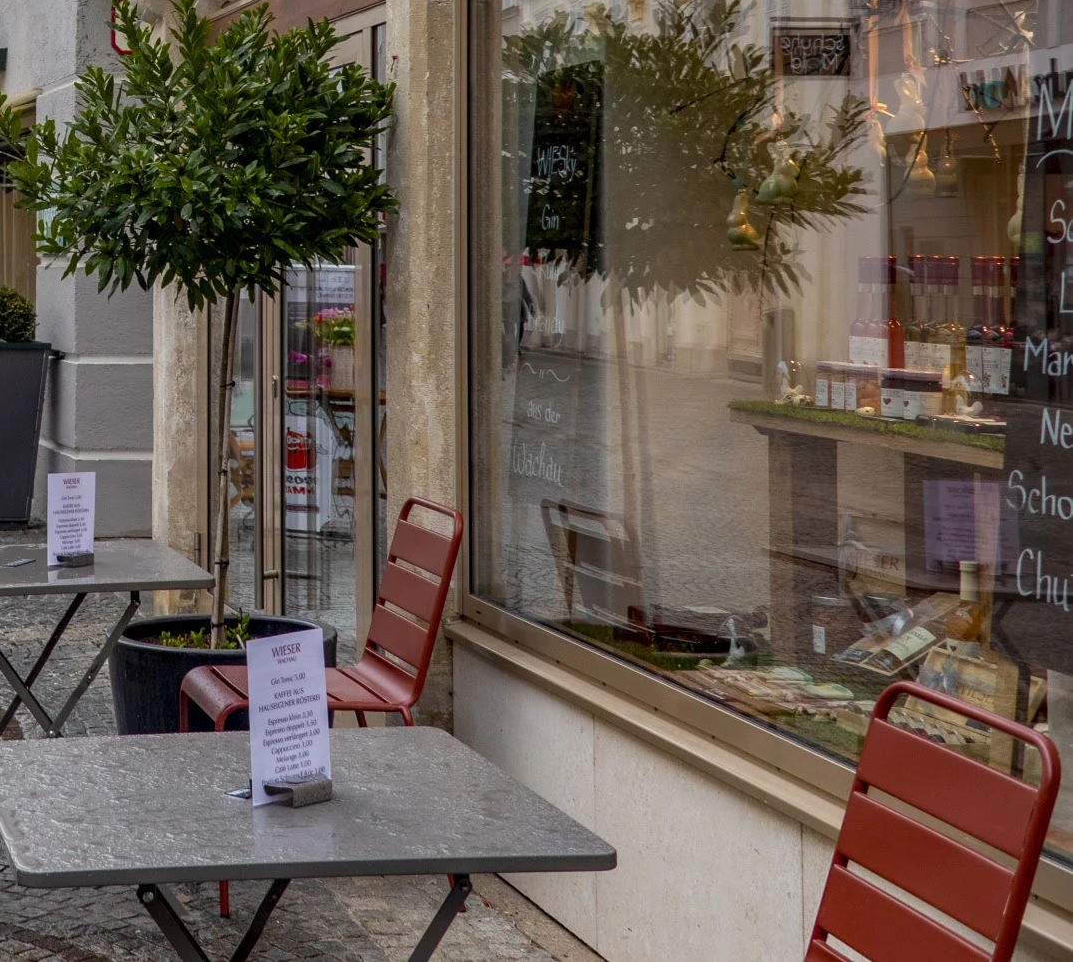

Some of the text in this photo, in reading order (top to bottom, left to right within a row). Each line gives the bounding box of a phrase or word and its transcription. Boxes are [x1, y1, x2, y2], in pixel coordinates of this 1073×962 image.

[542, 203, 559, 230] Gin
[527, 400, 561, 424] aus der
[512, 439, 564, 488] Wachau
[1005, 470, 1073, 520] Scho
[1016, 549, 1073, 612] Chu
[271, 642, 302, 658] WIESER
[277, 656, 297, 664] WACHAU
[271, 678, 281, 686] Gin
[273, 687, 304, 700] KAFFEE AUS
[258, 694, 321, 713] HAUSEIGENER RÖSTEREI
[268, 717, 288, 726] Espresso
[288, 713, 301, 721] klein
[265, 726, 286, 737] Espresso
[286, 722, 305, 733] doppelt
[263, 737, 284, 747] Espresso
[284, 731, 308, 741] verlängert
[271, 744, 301, 755] Cappuccino
[275, 765, 287, 774] Café
[287, 763, 299, 771] Latte
